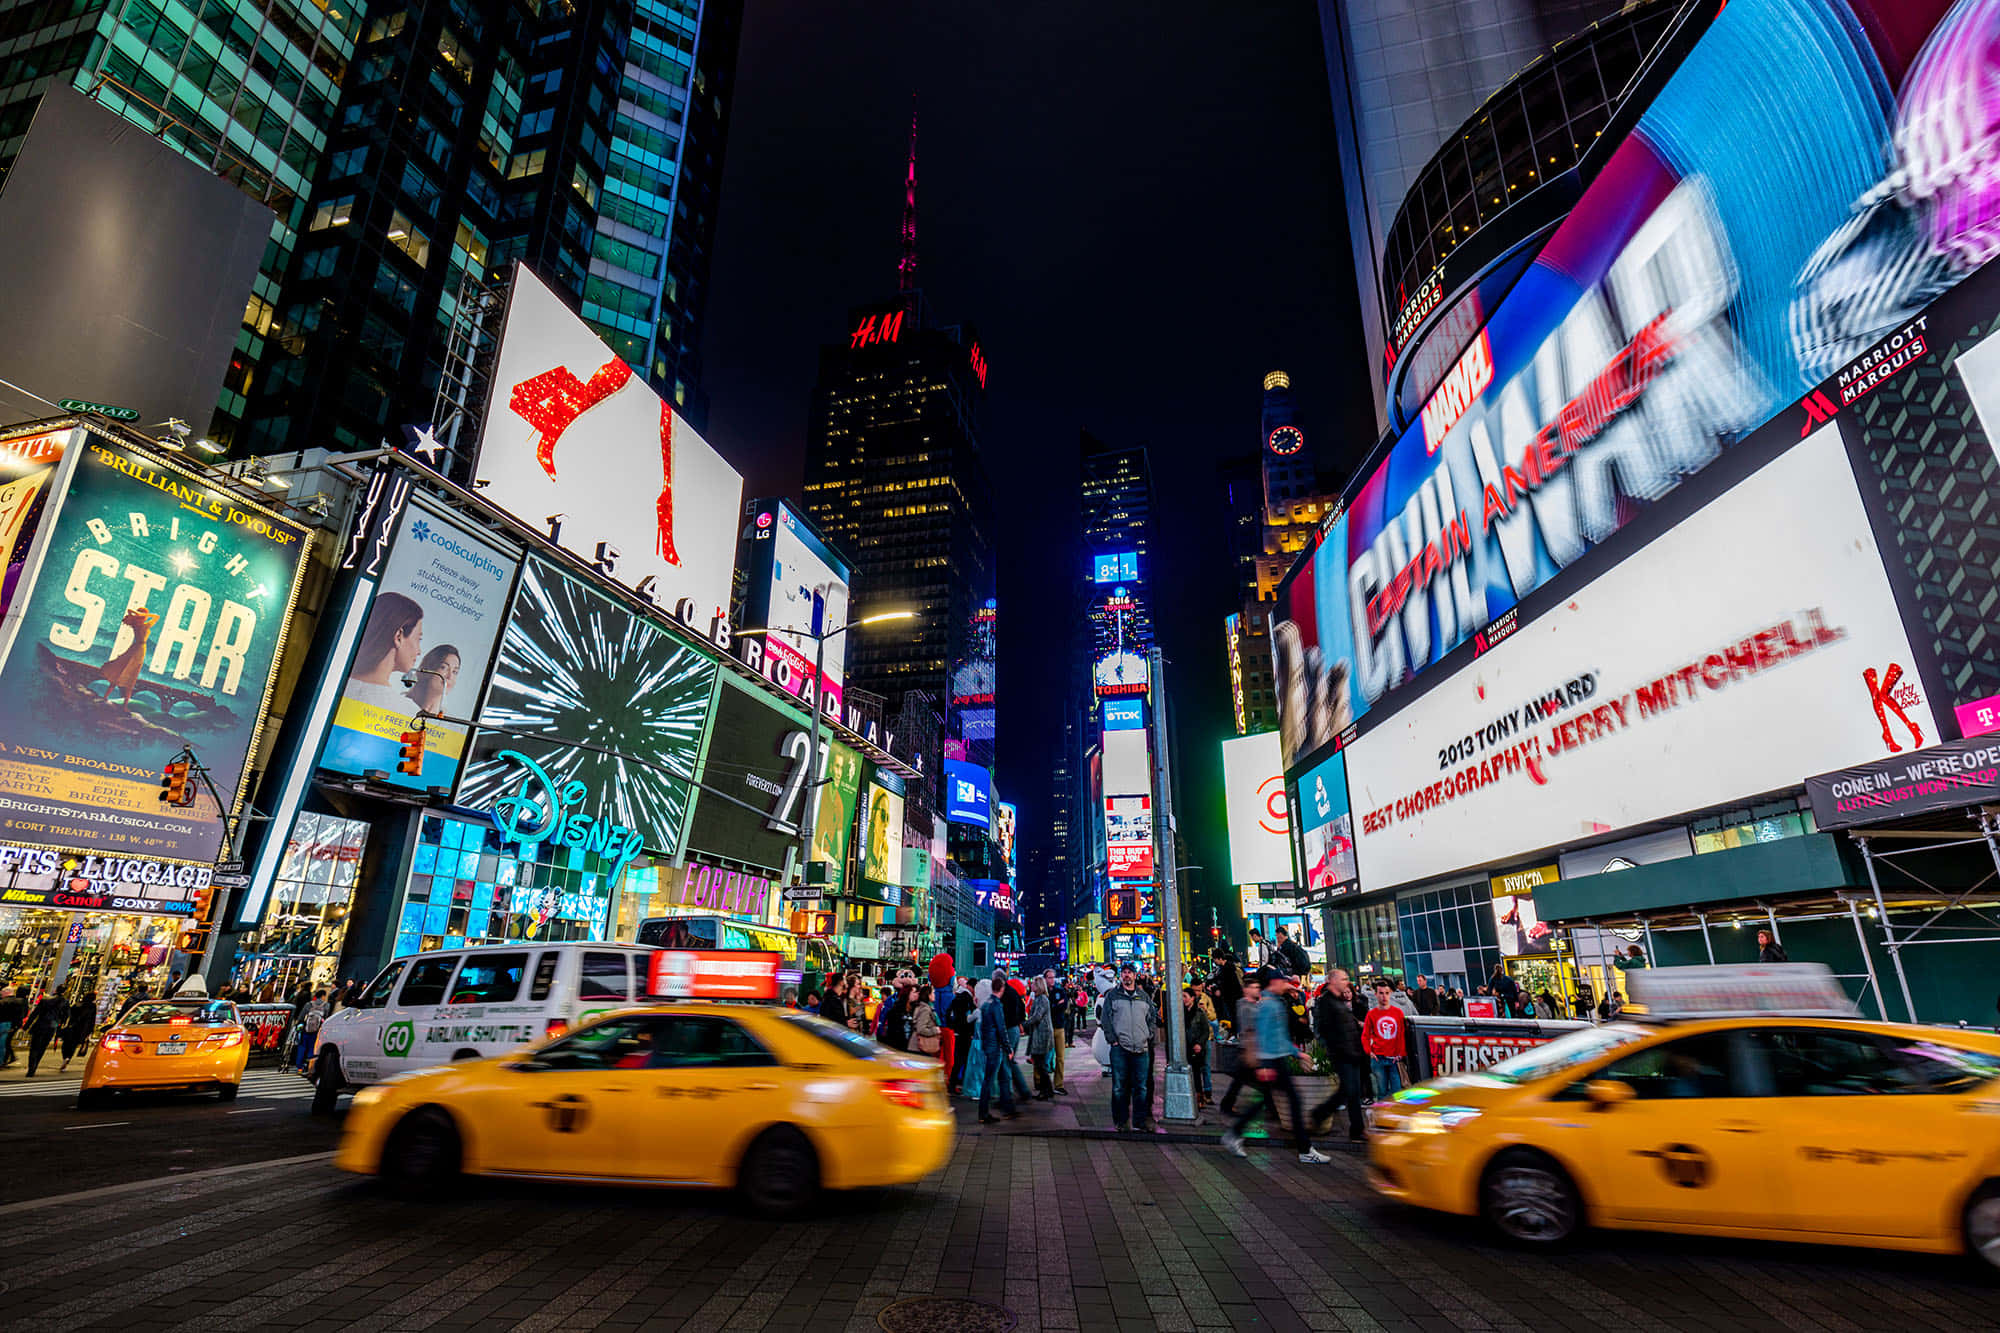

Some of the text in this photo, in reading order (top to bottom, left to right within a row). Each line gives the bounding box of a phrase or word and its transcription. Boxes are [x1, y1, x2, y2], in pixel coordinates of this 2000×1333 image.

[1396, 265, 1445, 336] MARRIOTT
[851, 310, 904, 349] H&M
[1397, 289, 1440, 350] MARQUIS
[1839, 315, 1928, 387] MARRIOTT
[1843, 340, 1923, 403] MARQUIS
[64, 400, 130, 418] LAMAR
[1420, 333, 1494, 456] MARVEL
[90, 444, 297, 546] "BRILLIANT & JOYOUS!"
[756, 529, 770, 540] LG
[86, 511, 269, 600] BRIGHT
[430, 533, 504, 582] coolsculpting
[410, 580, 429, 594] with
[417, 568, 455, 591] stubborn
[431, 558, 480, 591] Freeze away
[48, 548, 257, 696] STAR
[709, 614, 894, 754] BROADWAY
[1096, 683, 1148, 695] TOSHIBA
[385, 714, 403, 728] FREE
[1114, 710, 1140, 721] TDK
[1438, 672, 1599, 770] 2013 TONY AWARD
[14, 744, 60, 760] NEW
[63, 754, 155, 778] BROADWAY
[1362, 803, 1393, 836] BEST
[1546, 693, 1631, 758] JERRY
[1832, 775, 1874, 799] COME
[1874, 772, 1892, 791] IN
[1907, 755, 1962, 782] WE'RE
[1962, 747, 2000, 770] OPE
[69, 790, 144, 809] BRICKELL
[92, 785, 129, 799] EDIE
[1836, 768, 1998, 814] A LITTLE DUST WON'T STOP
[15, 820, 46, 832] CORT
[49, 825, 99, 839] THEATRE
[60, 877, 118, 897] I NY
[80, 855, 213, 889] LUGGAGE
[681, 862, 769, 915] FOREVER
[1503, 871, 1545, 893] INVICTA
[2, 889, 46, 903] Nikon
[53, 893, 104, 907] Canon
[112, 898, 161, 910] SONY
[385, 1025, 533, 1052] GO AIRLINK SHUTTLE
